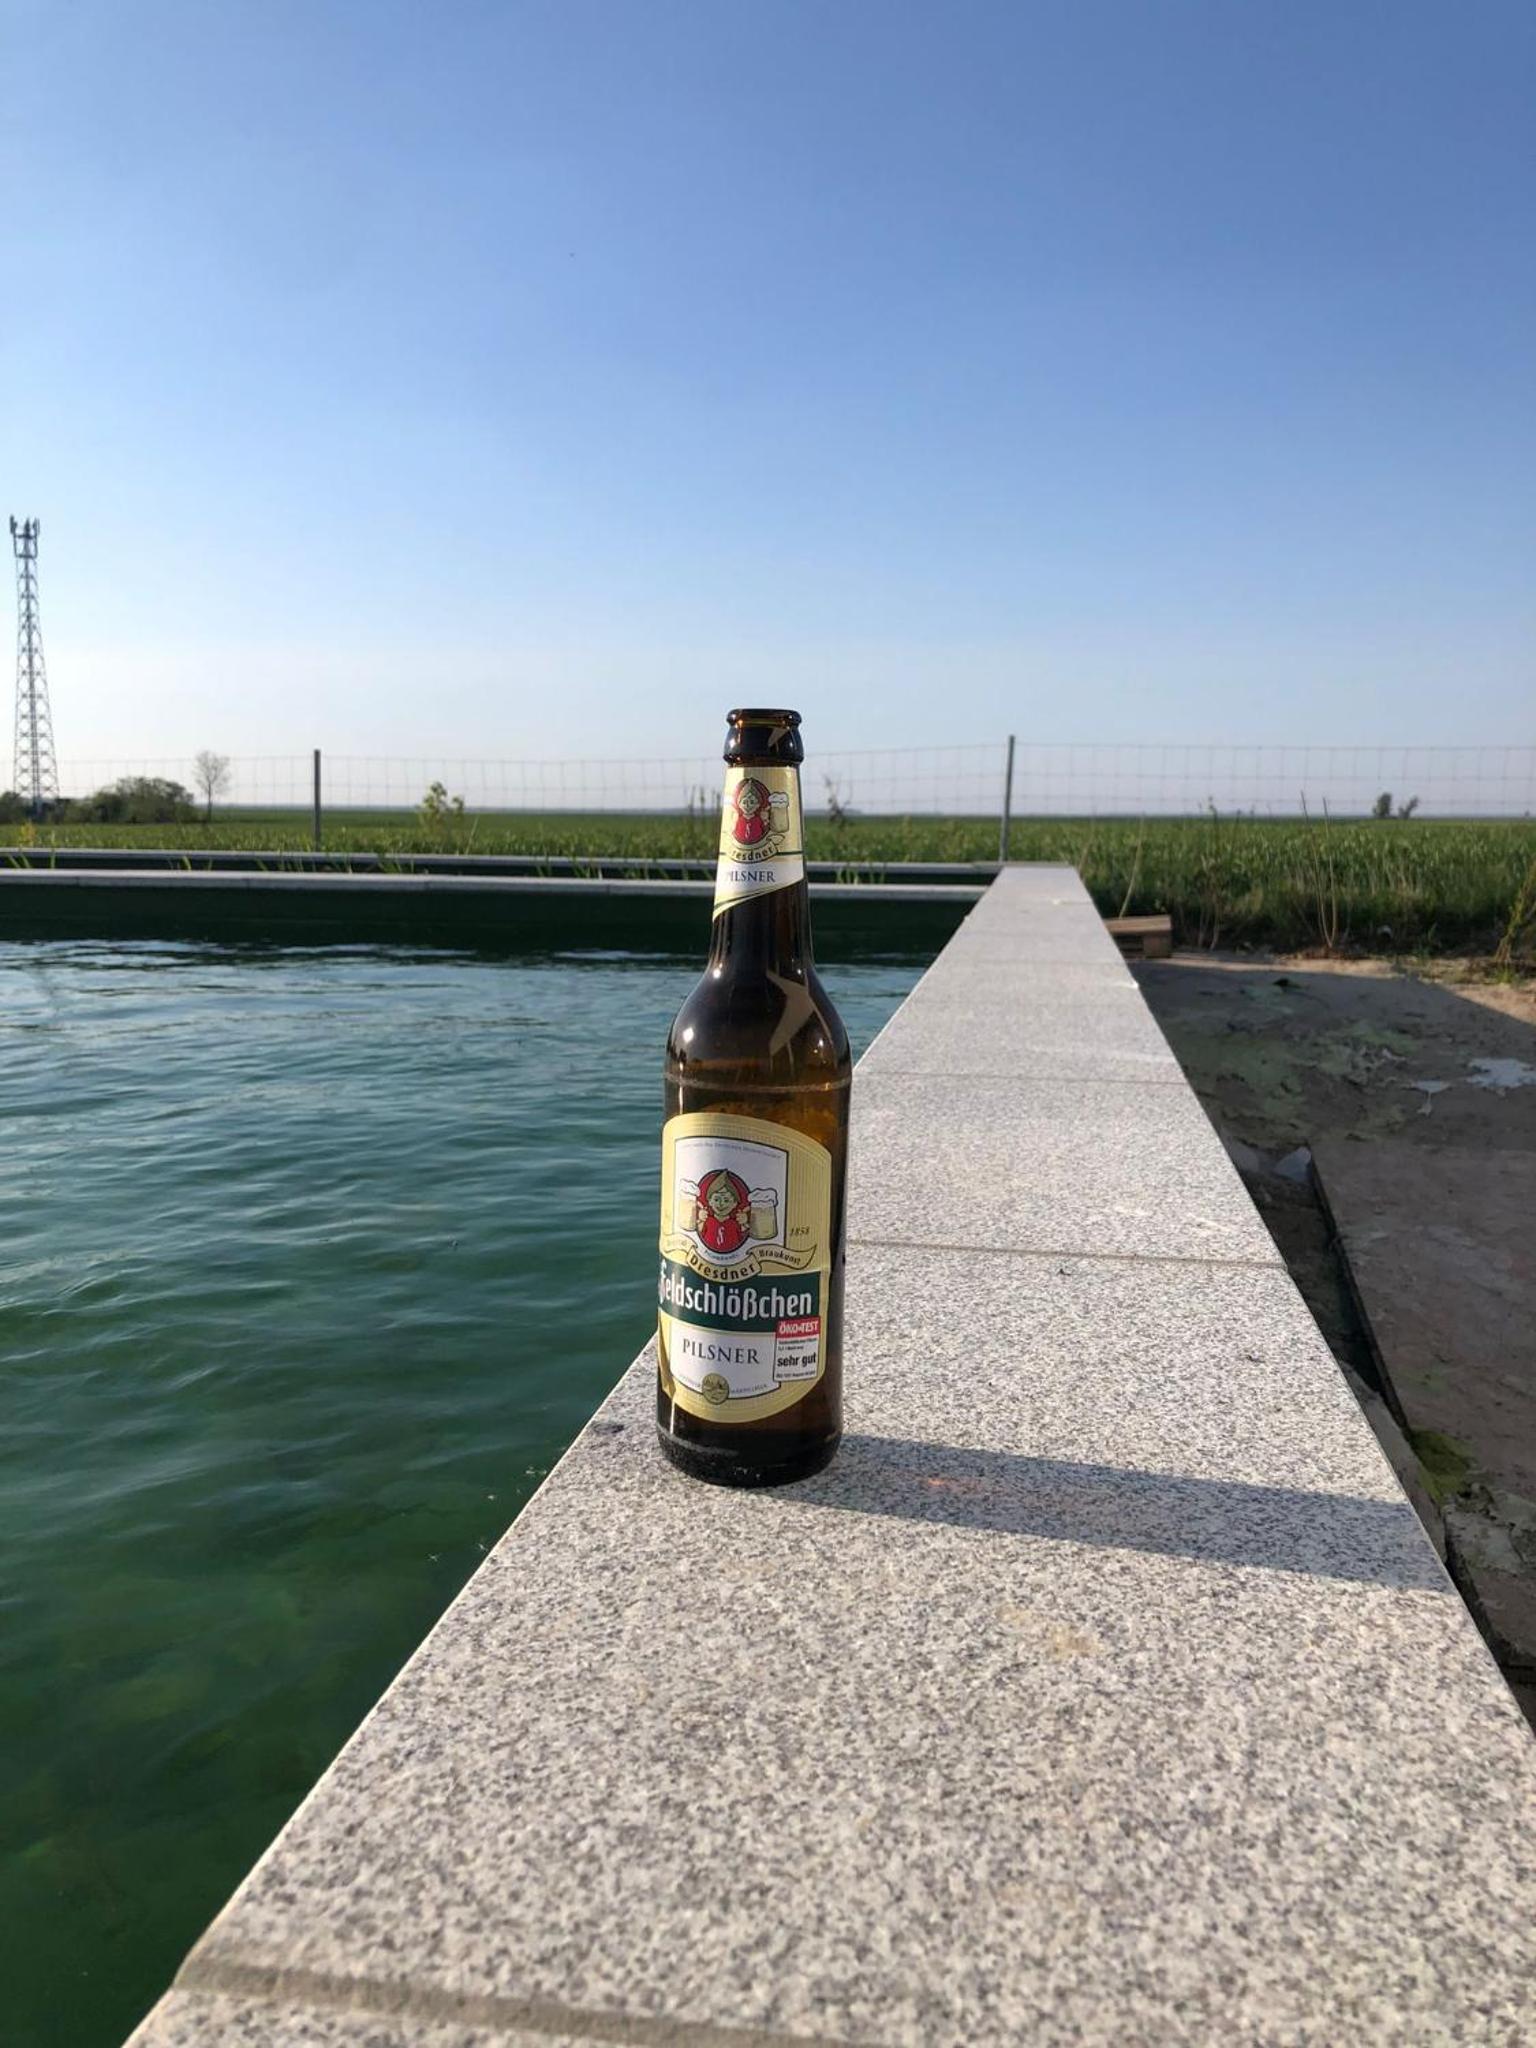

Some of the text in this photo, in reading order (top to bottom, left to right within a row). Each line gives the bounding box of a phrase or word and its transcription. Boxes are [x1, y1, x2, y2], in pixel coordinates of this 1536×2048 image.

[689, 1254, 756, 1281] Dresdner
[682, 1337, 760, 1365] PILSNER
[777, 1351, 817, 1368] sehr gut
